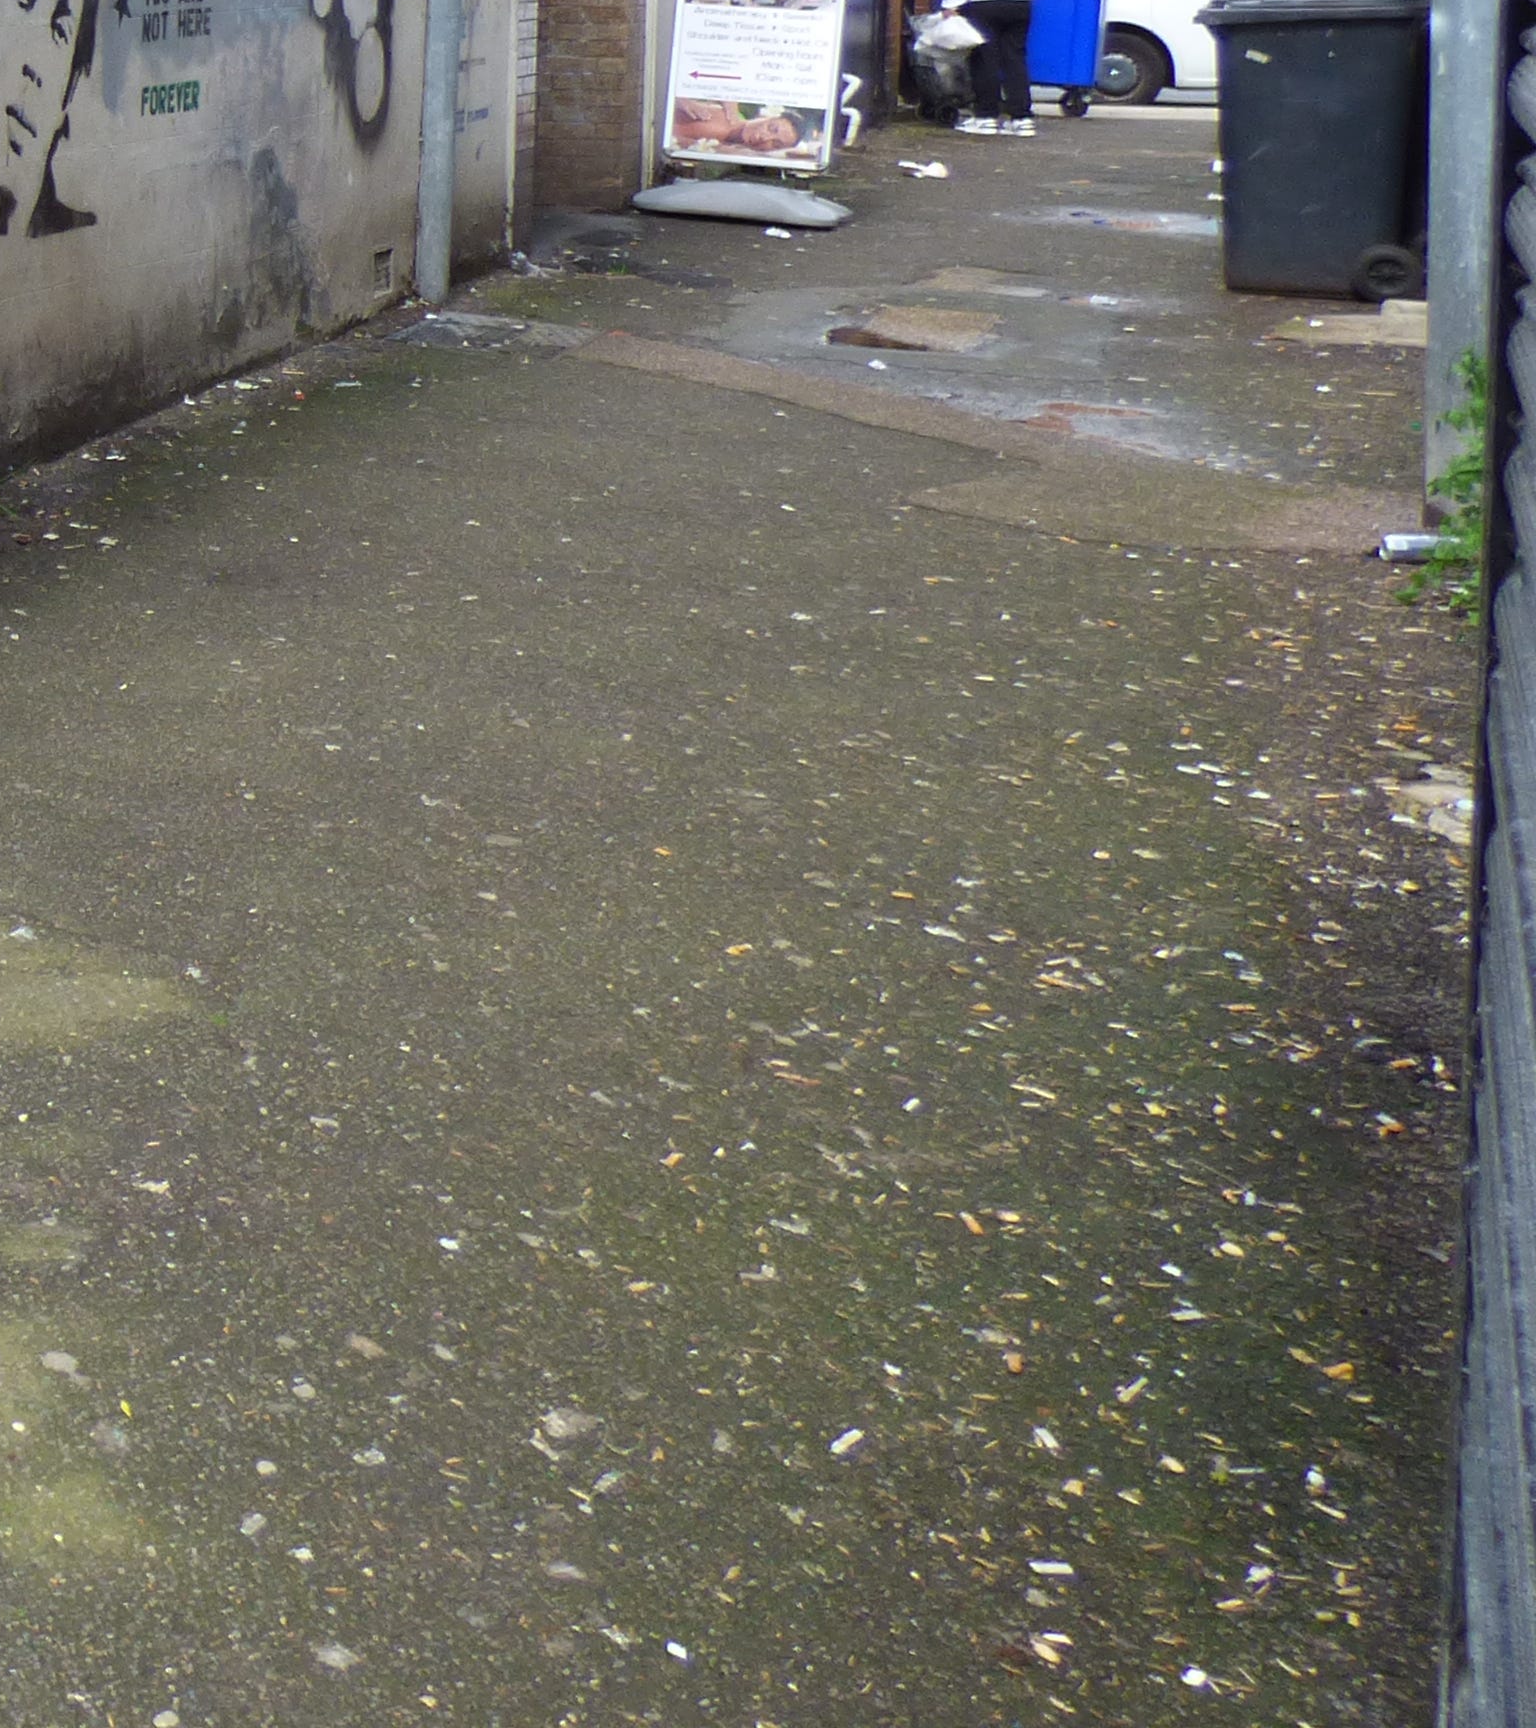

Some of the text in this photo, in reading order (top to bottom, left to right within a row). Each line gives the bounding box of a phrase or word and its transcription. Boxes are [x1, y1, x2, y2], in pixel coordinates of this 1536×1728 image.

[141, 8, 212, 43] NOT HERE
[141, 80, 200, 117] FOREVER
